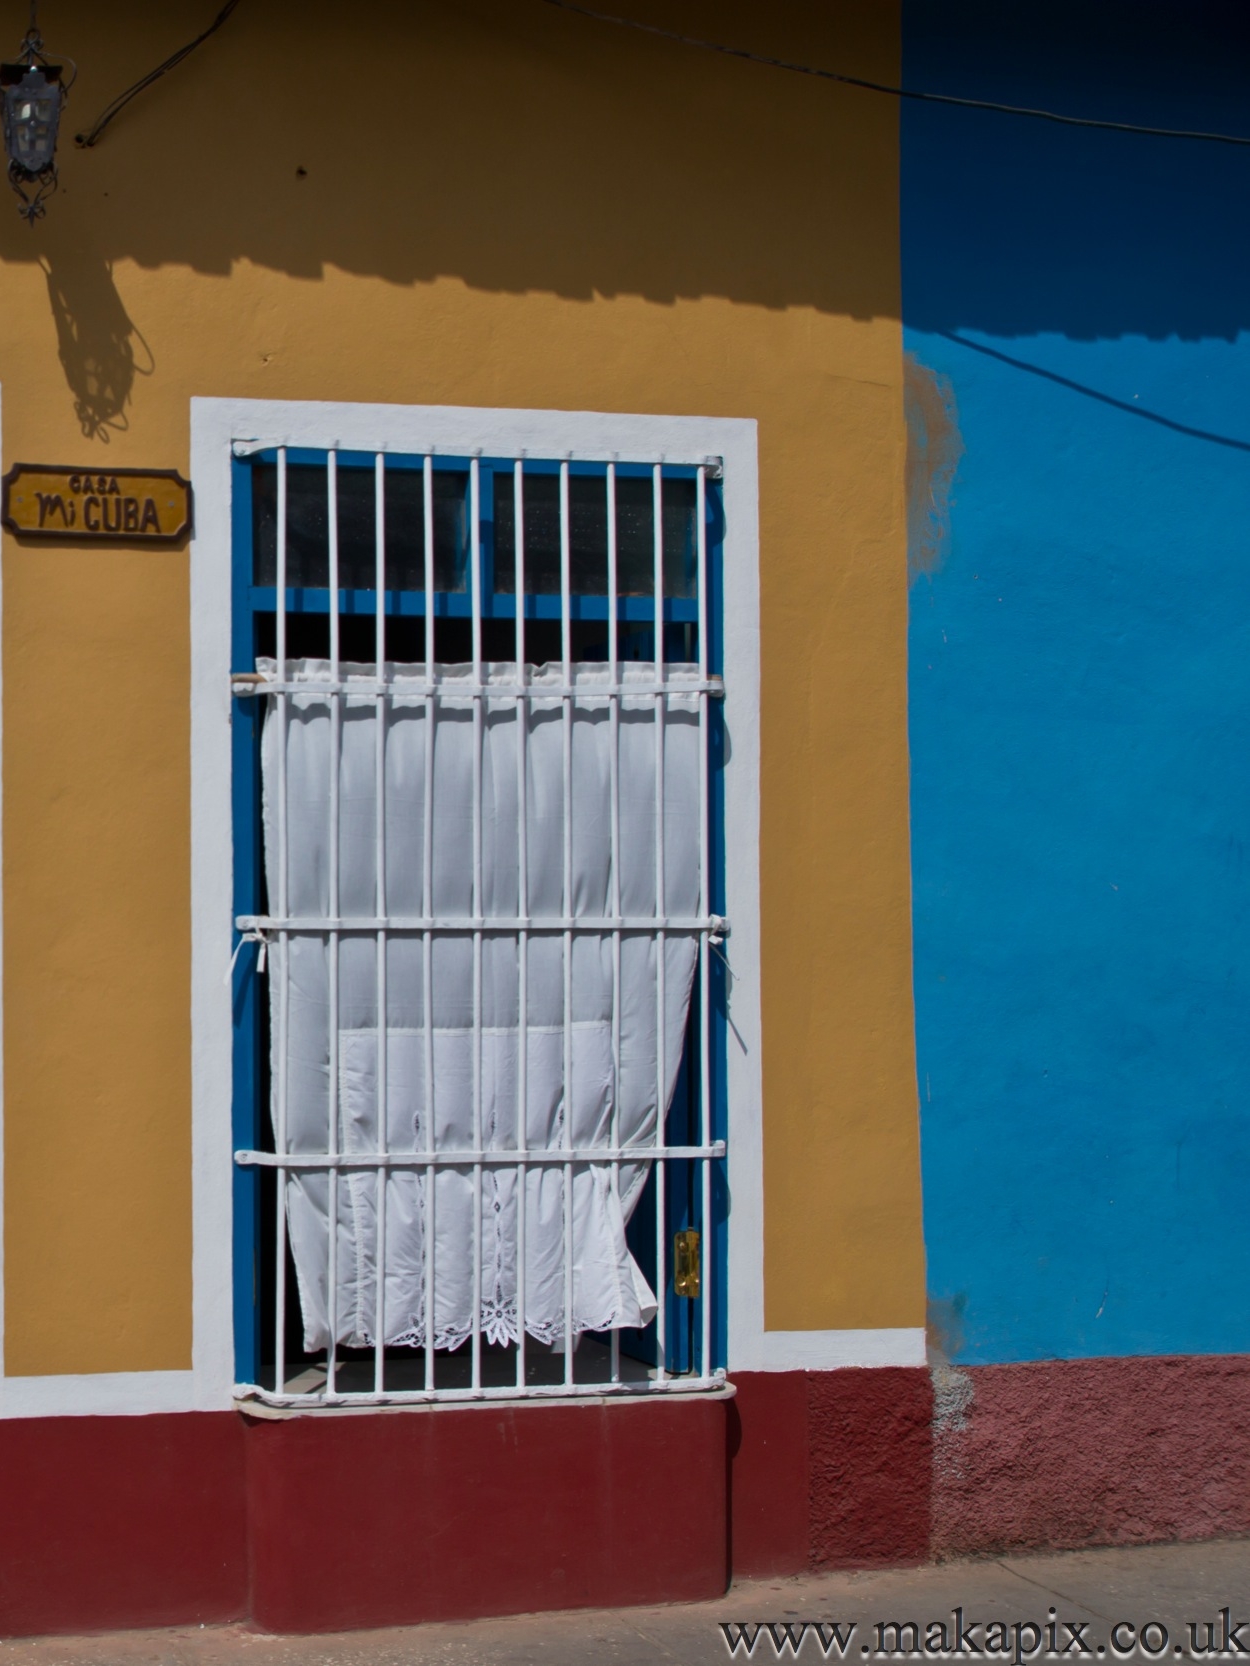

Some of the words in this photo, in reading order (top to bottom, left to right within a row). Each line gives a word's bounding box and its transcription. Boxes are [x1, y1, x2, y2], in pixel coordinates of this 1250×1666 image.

[68, 474, 121, 496] CASA
[33, 491, 76, 528] Mi
[83, 495, 162, 534] CUBA
